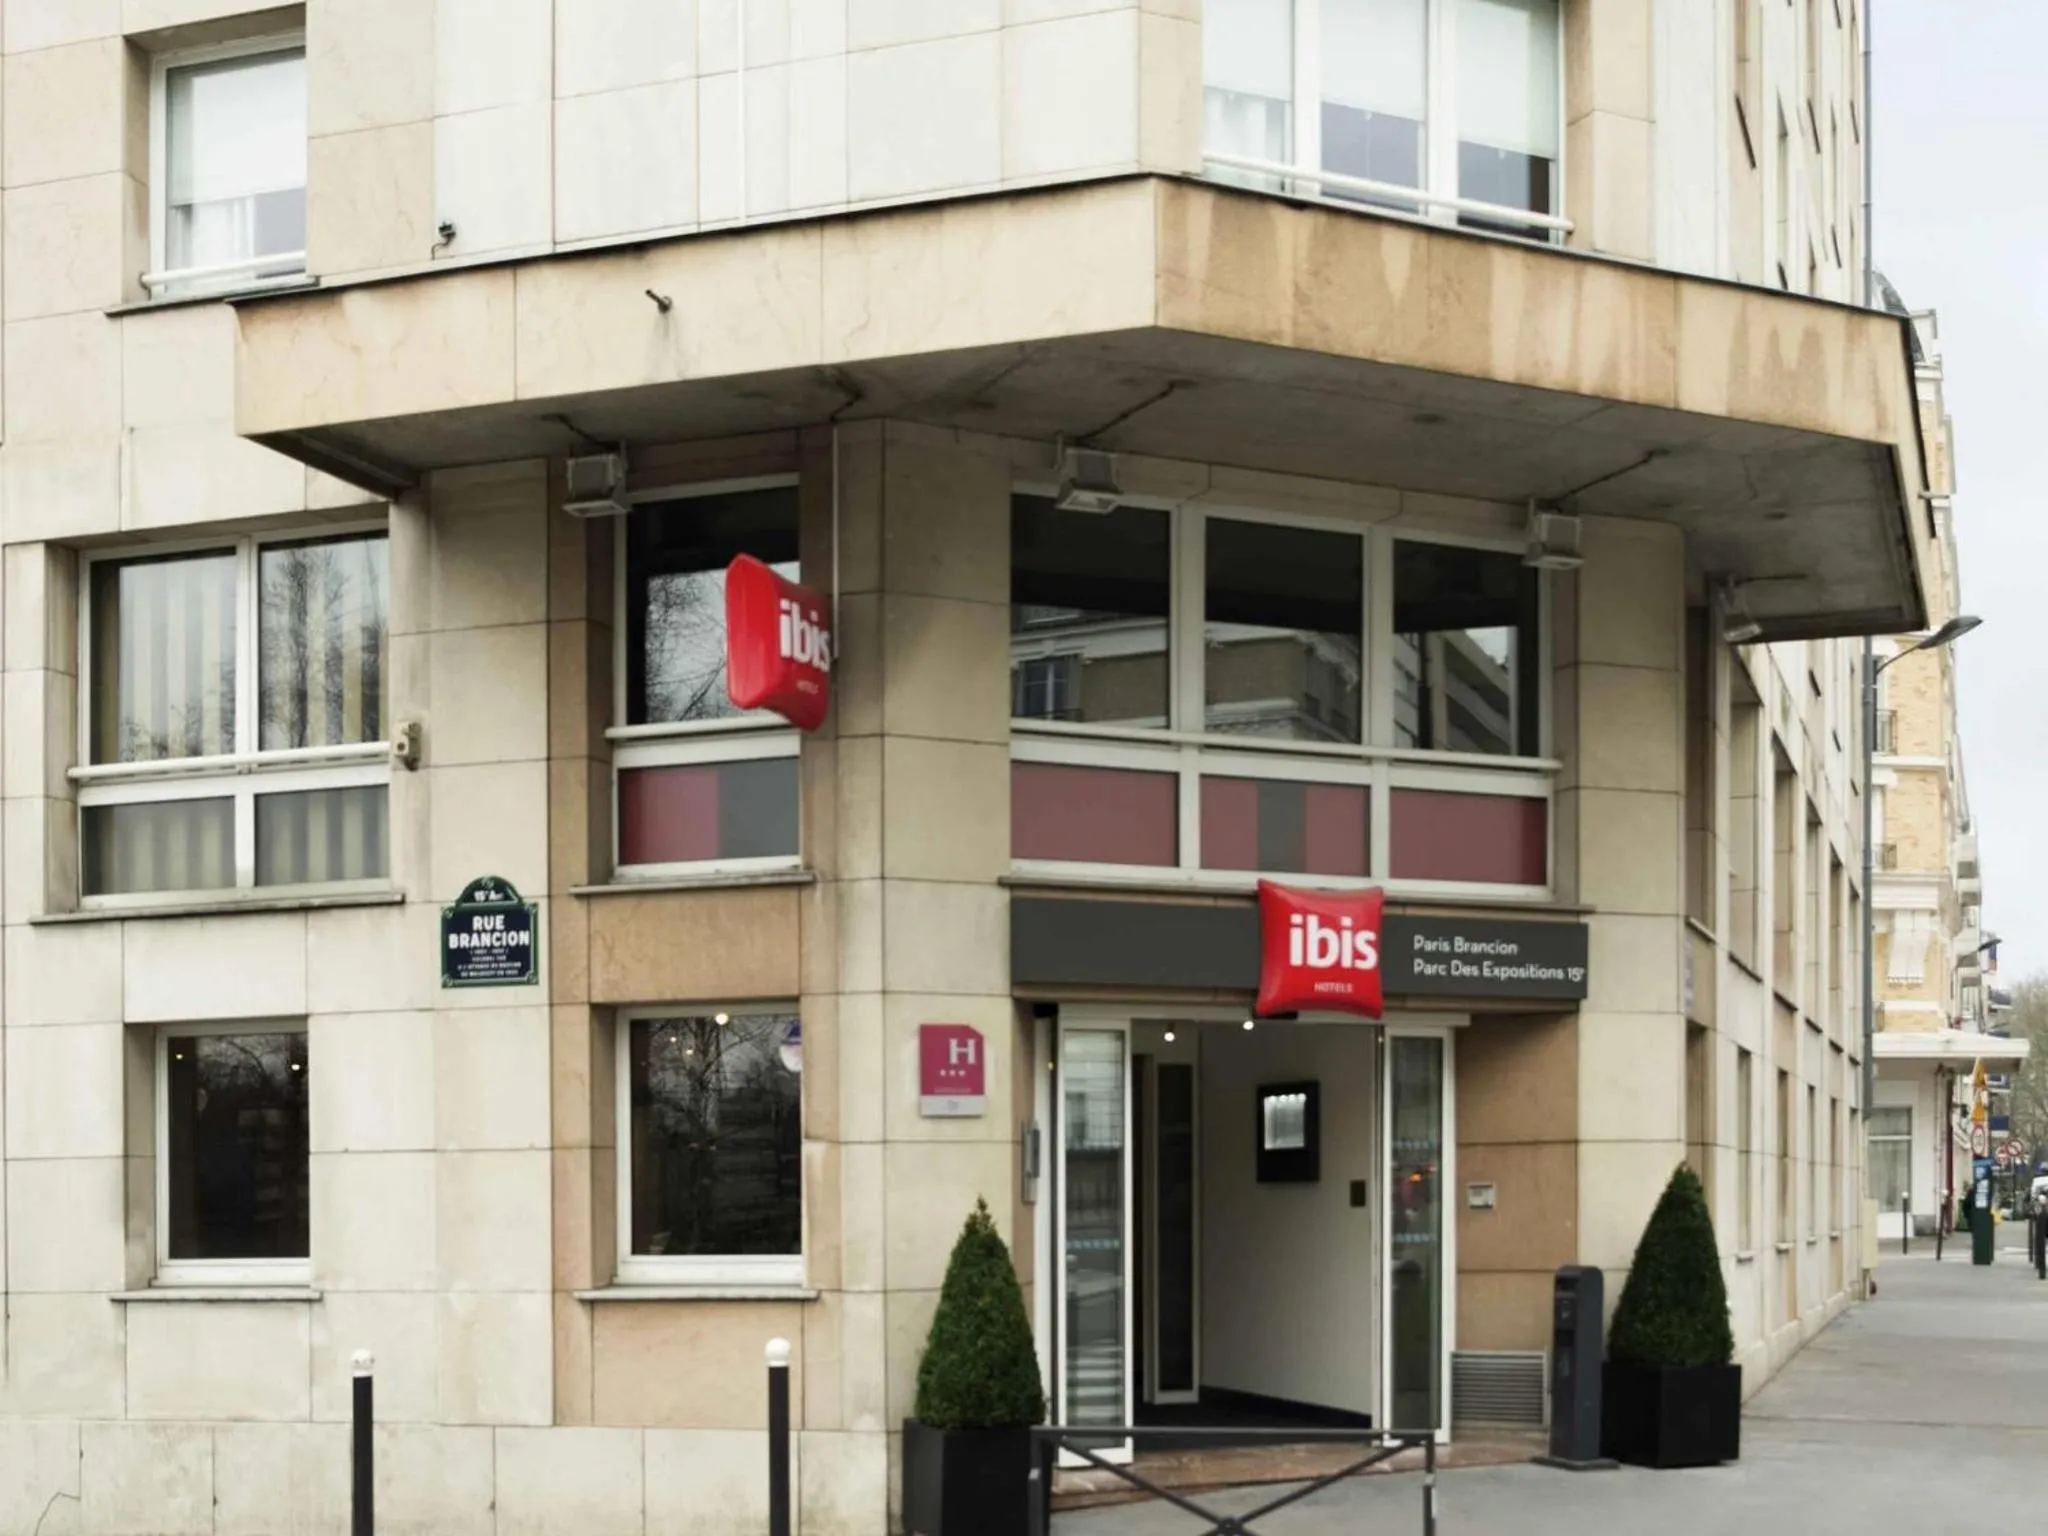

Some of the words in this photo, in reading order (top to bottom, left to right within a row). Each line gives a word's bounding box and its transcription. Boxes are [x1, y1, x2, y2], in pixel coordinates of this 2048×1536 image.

[780, 598, 829, 672] ibis
[472, 915, 505, 931] RUE
[449, 931, 530, 949] BRANCION
[1290, 913, 1377, 969] ibis
[1414, 935, 1450, 952] Paris
[1453, 936, 1518, 955] Brancion
[1414, 958, 1448, 975] Parc
[1451, 960, 1479, 977] Des
[1483, 961, 1564, 980] Expositions
[1314, 982, 1352, 993] HOTELS
[949, 1038, 976, 1064] H
